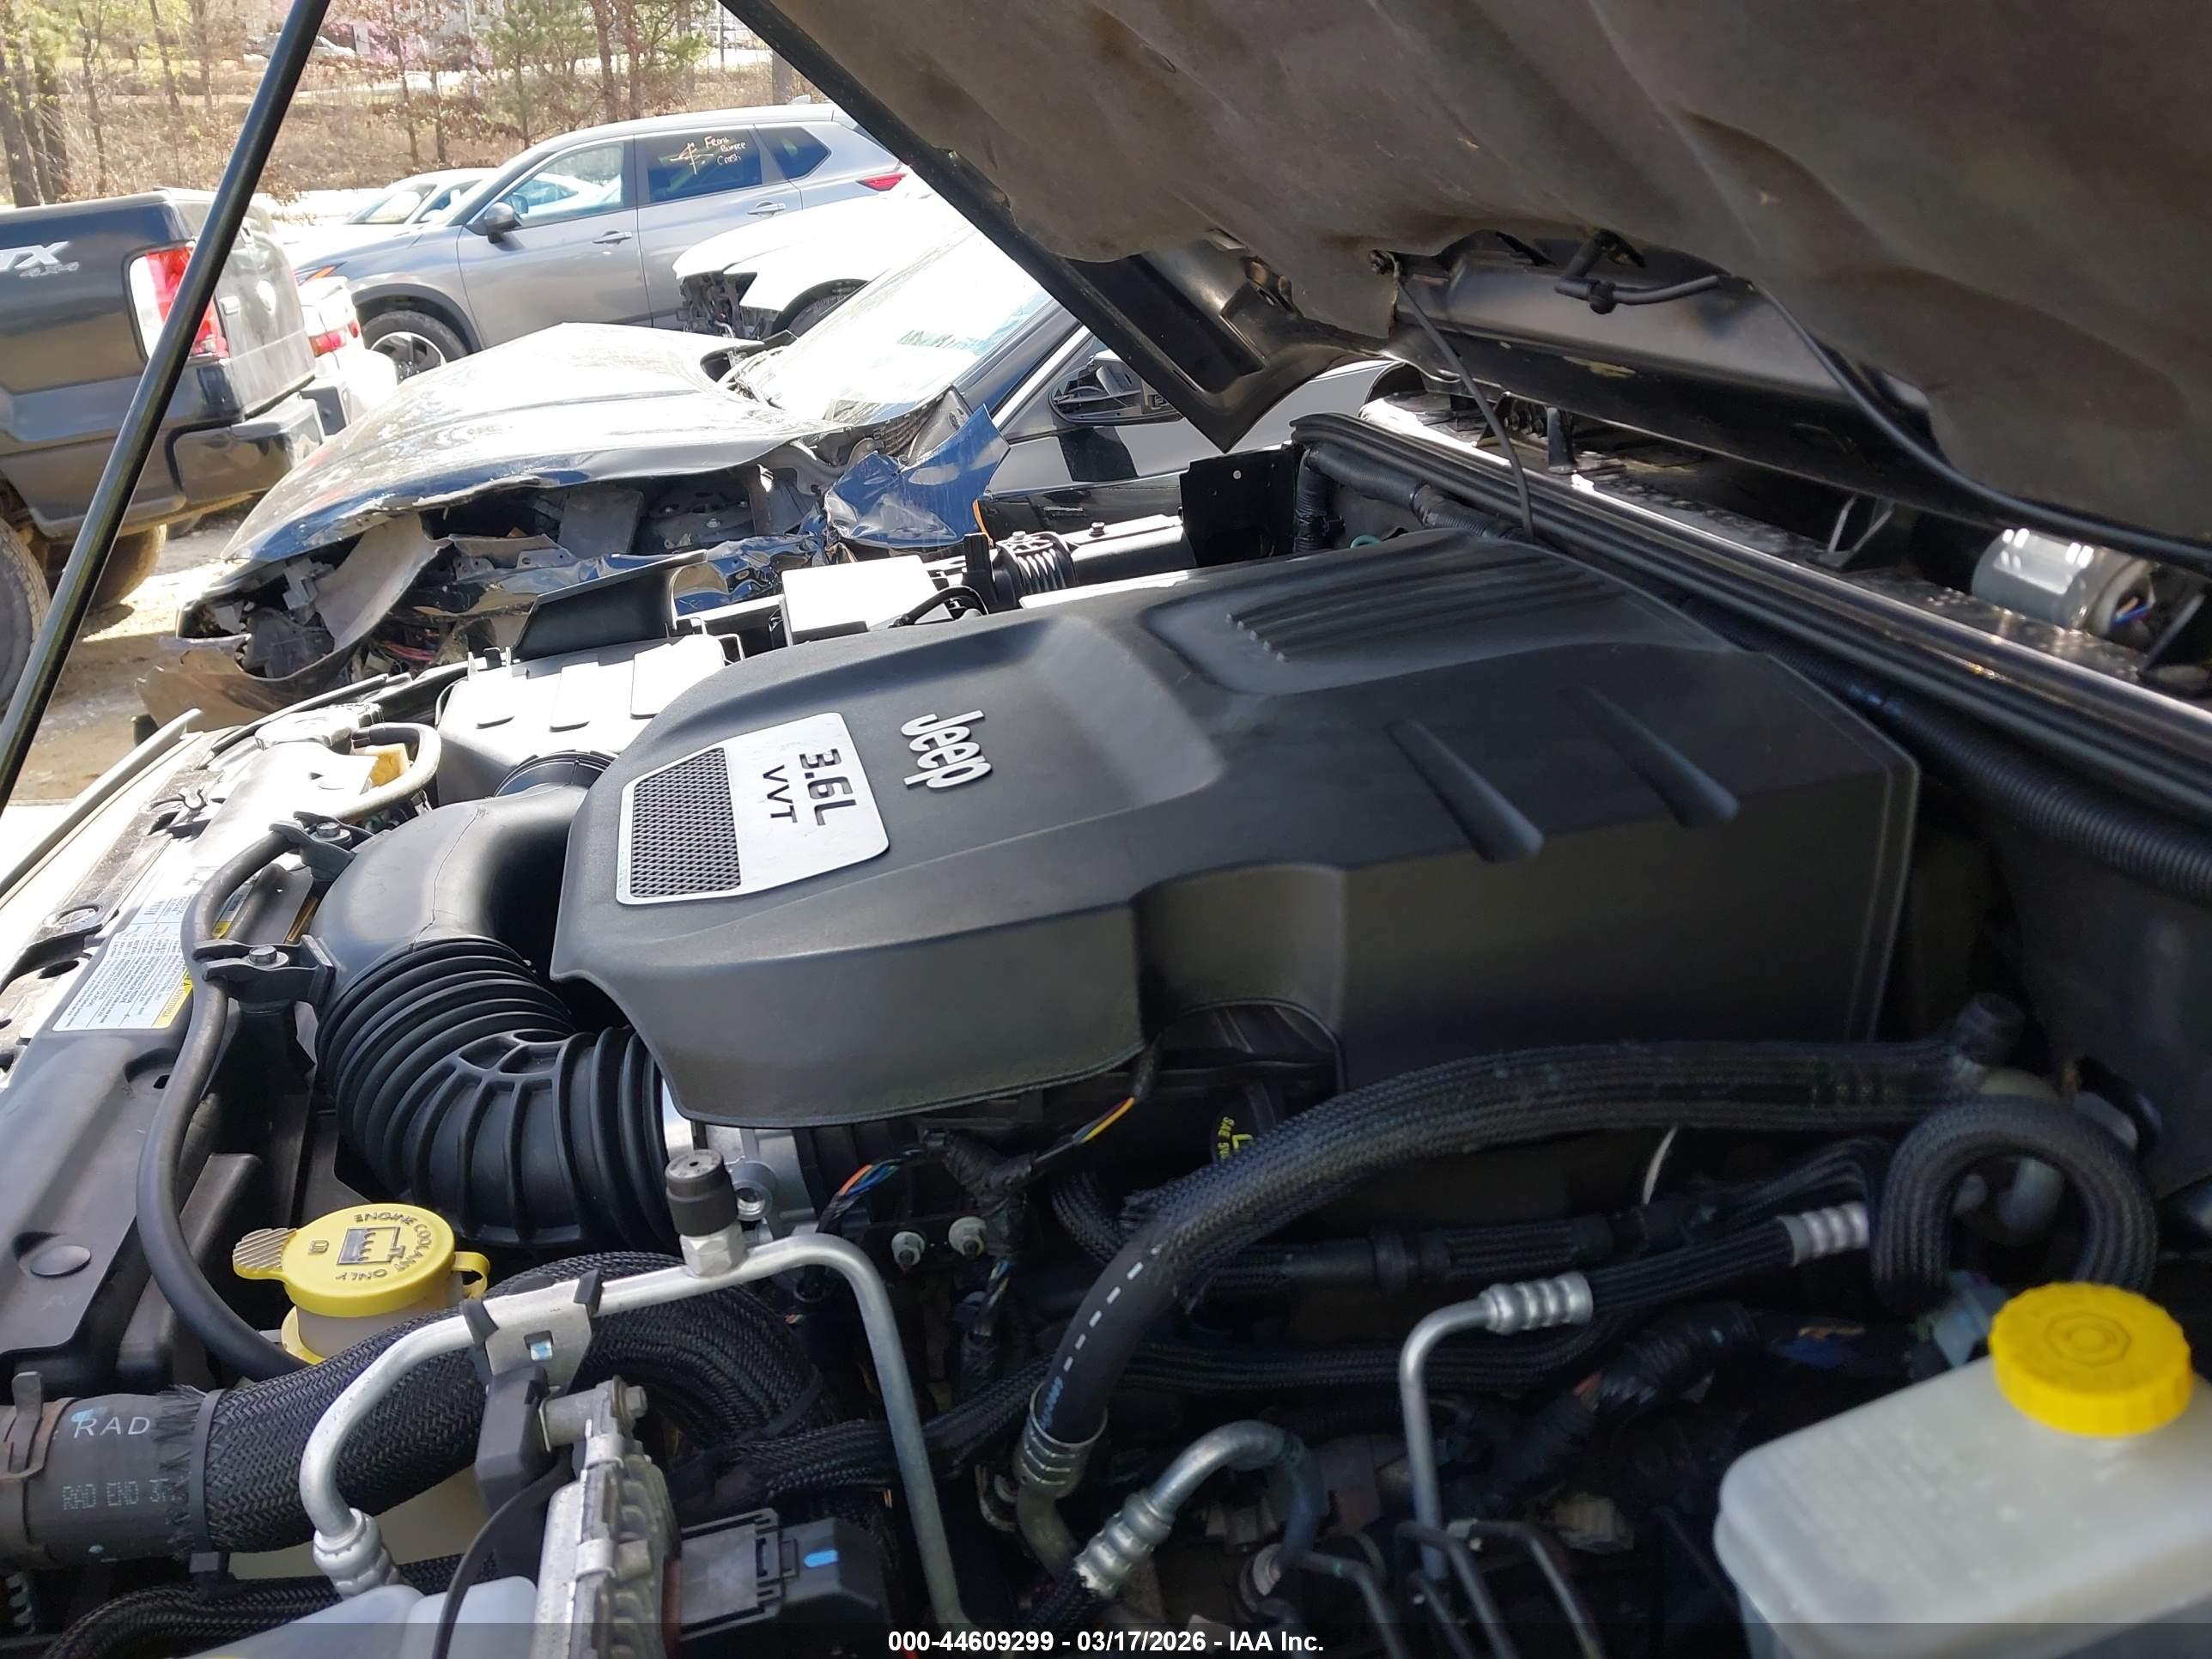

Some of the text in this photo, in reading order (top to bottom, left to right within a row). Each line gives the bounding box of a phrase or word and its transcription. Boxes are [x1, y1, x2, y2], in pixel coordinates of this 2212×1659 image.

[901, 709, 993, 789] Jeep
[763, 764, 798, 823] VVT
[799, 748, 857, 826] 3.6L
[354, 1212, 418, 1225] ENGINE
[335, 1269, 388, 1280] ONLY
[74, 1415, 149, 1438] RAD
